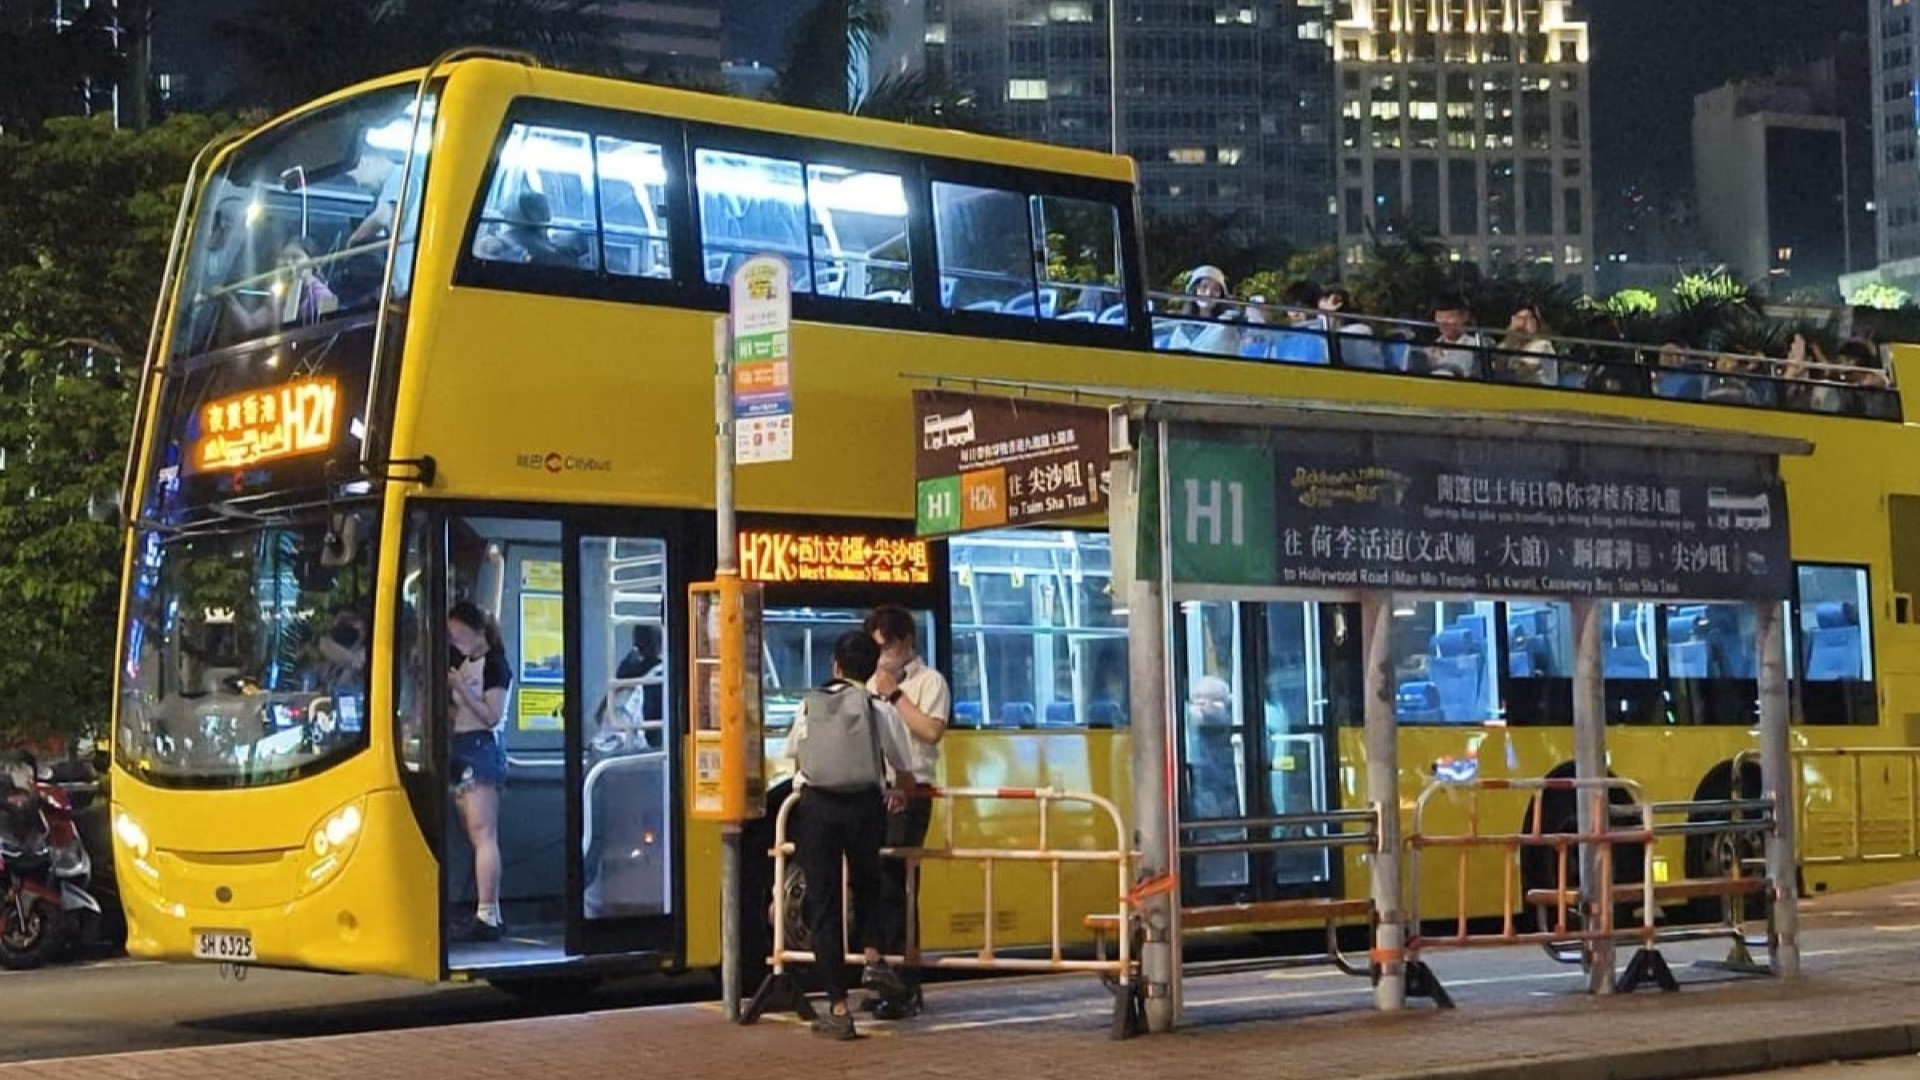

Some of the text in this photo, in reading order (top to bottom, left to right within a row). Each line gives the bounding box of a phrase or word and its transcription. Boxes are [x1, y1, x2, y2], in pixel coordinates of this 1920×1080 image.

[1029, 460, 1083, 494] 尖沙咀
[928, 492, 950, 519] H1
[970, 484, 997, 512] H2K
[1021, 500, 1044, 514] Tsim
[1046, 496, 1065, 511] Sha
[1184, 478, 1244, 546] H1
[872, 537, 927, 567] 尖沙咀
[1285, 528, 1301, 556] 往
[739, 532, 792, 581] H2K
[1285, 568, 1296, 580] to
[1300, 567, 1357, 584] Hollywood
[1360, 570, 1388, 584] Road
[202, 934, 252, 957] SH 6325
